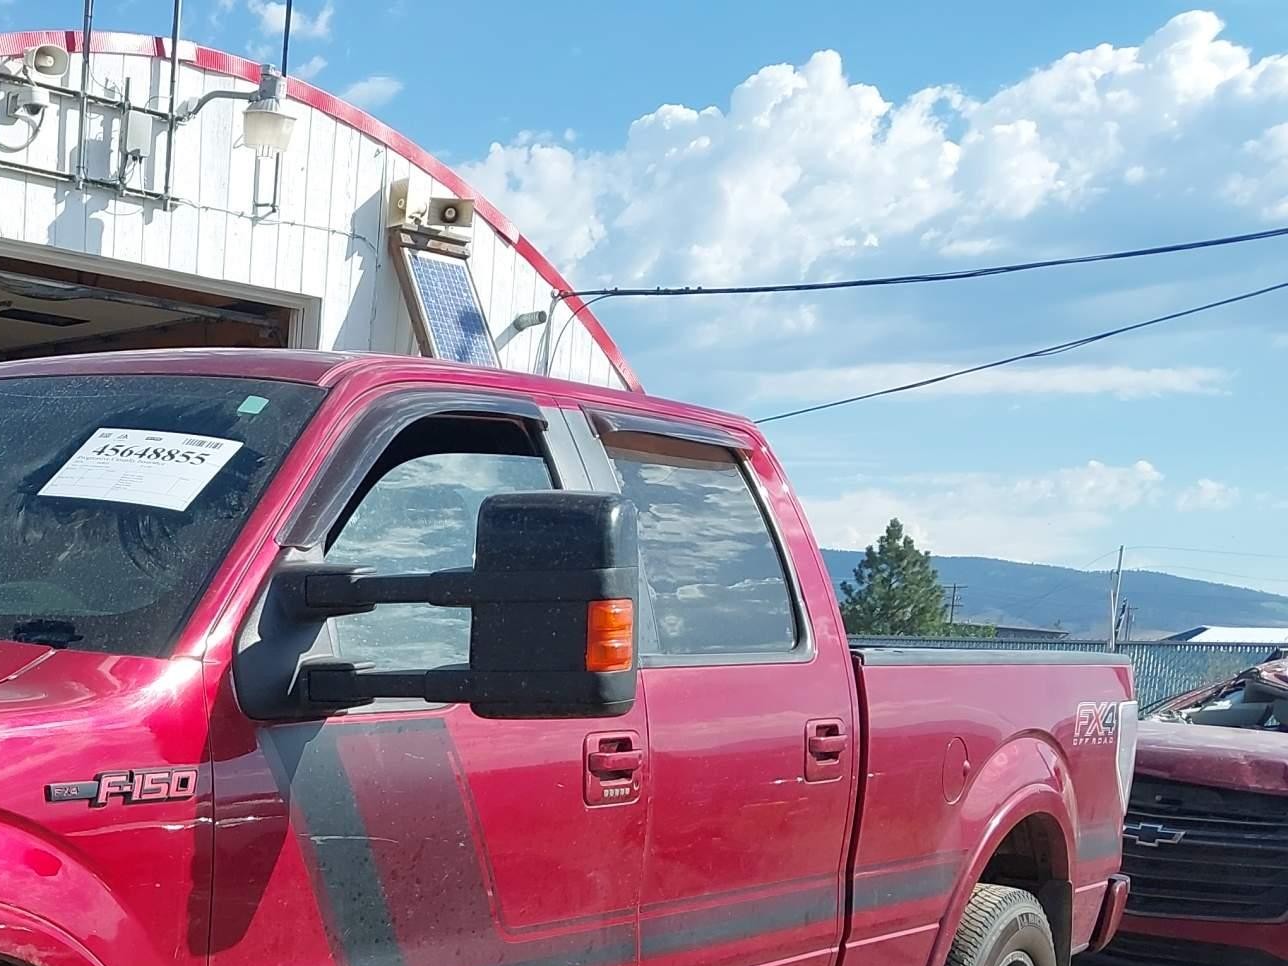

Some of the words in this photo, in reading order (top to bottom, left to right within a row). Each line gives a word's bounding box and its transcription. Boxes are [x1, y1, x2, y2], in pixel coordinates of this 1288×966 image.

[93, 443, 211, 466] 45648855
[1074, 702, 1116, 736] FX4
[1073, 737, 1090, 746] OFF
[1092, 737, 1114, 745] ROAD
[97, 769, 198, 804] F-150
